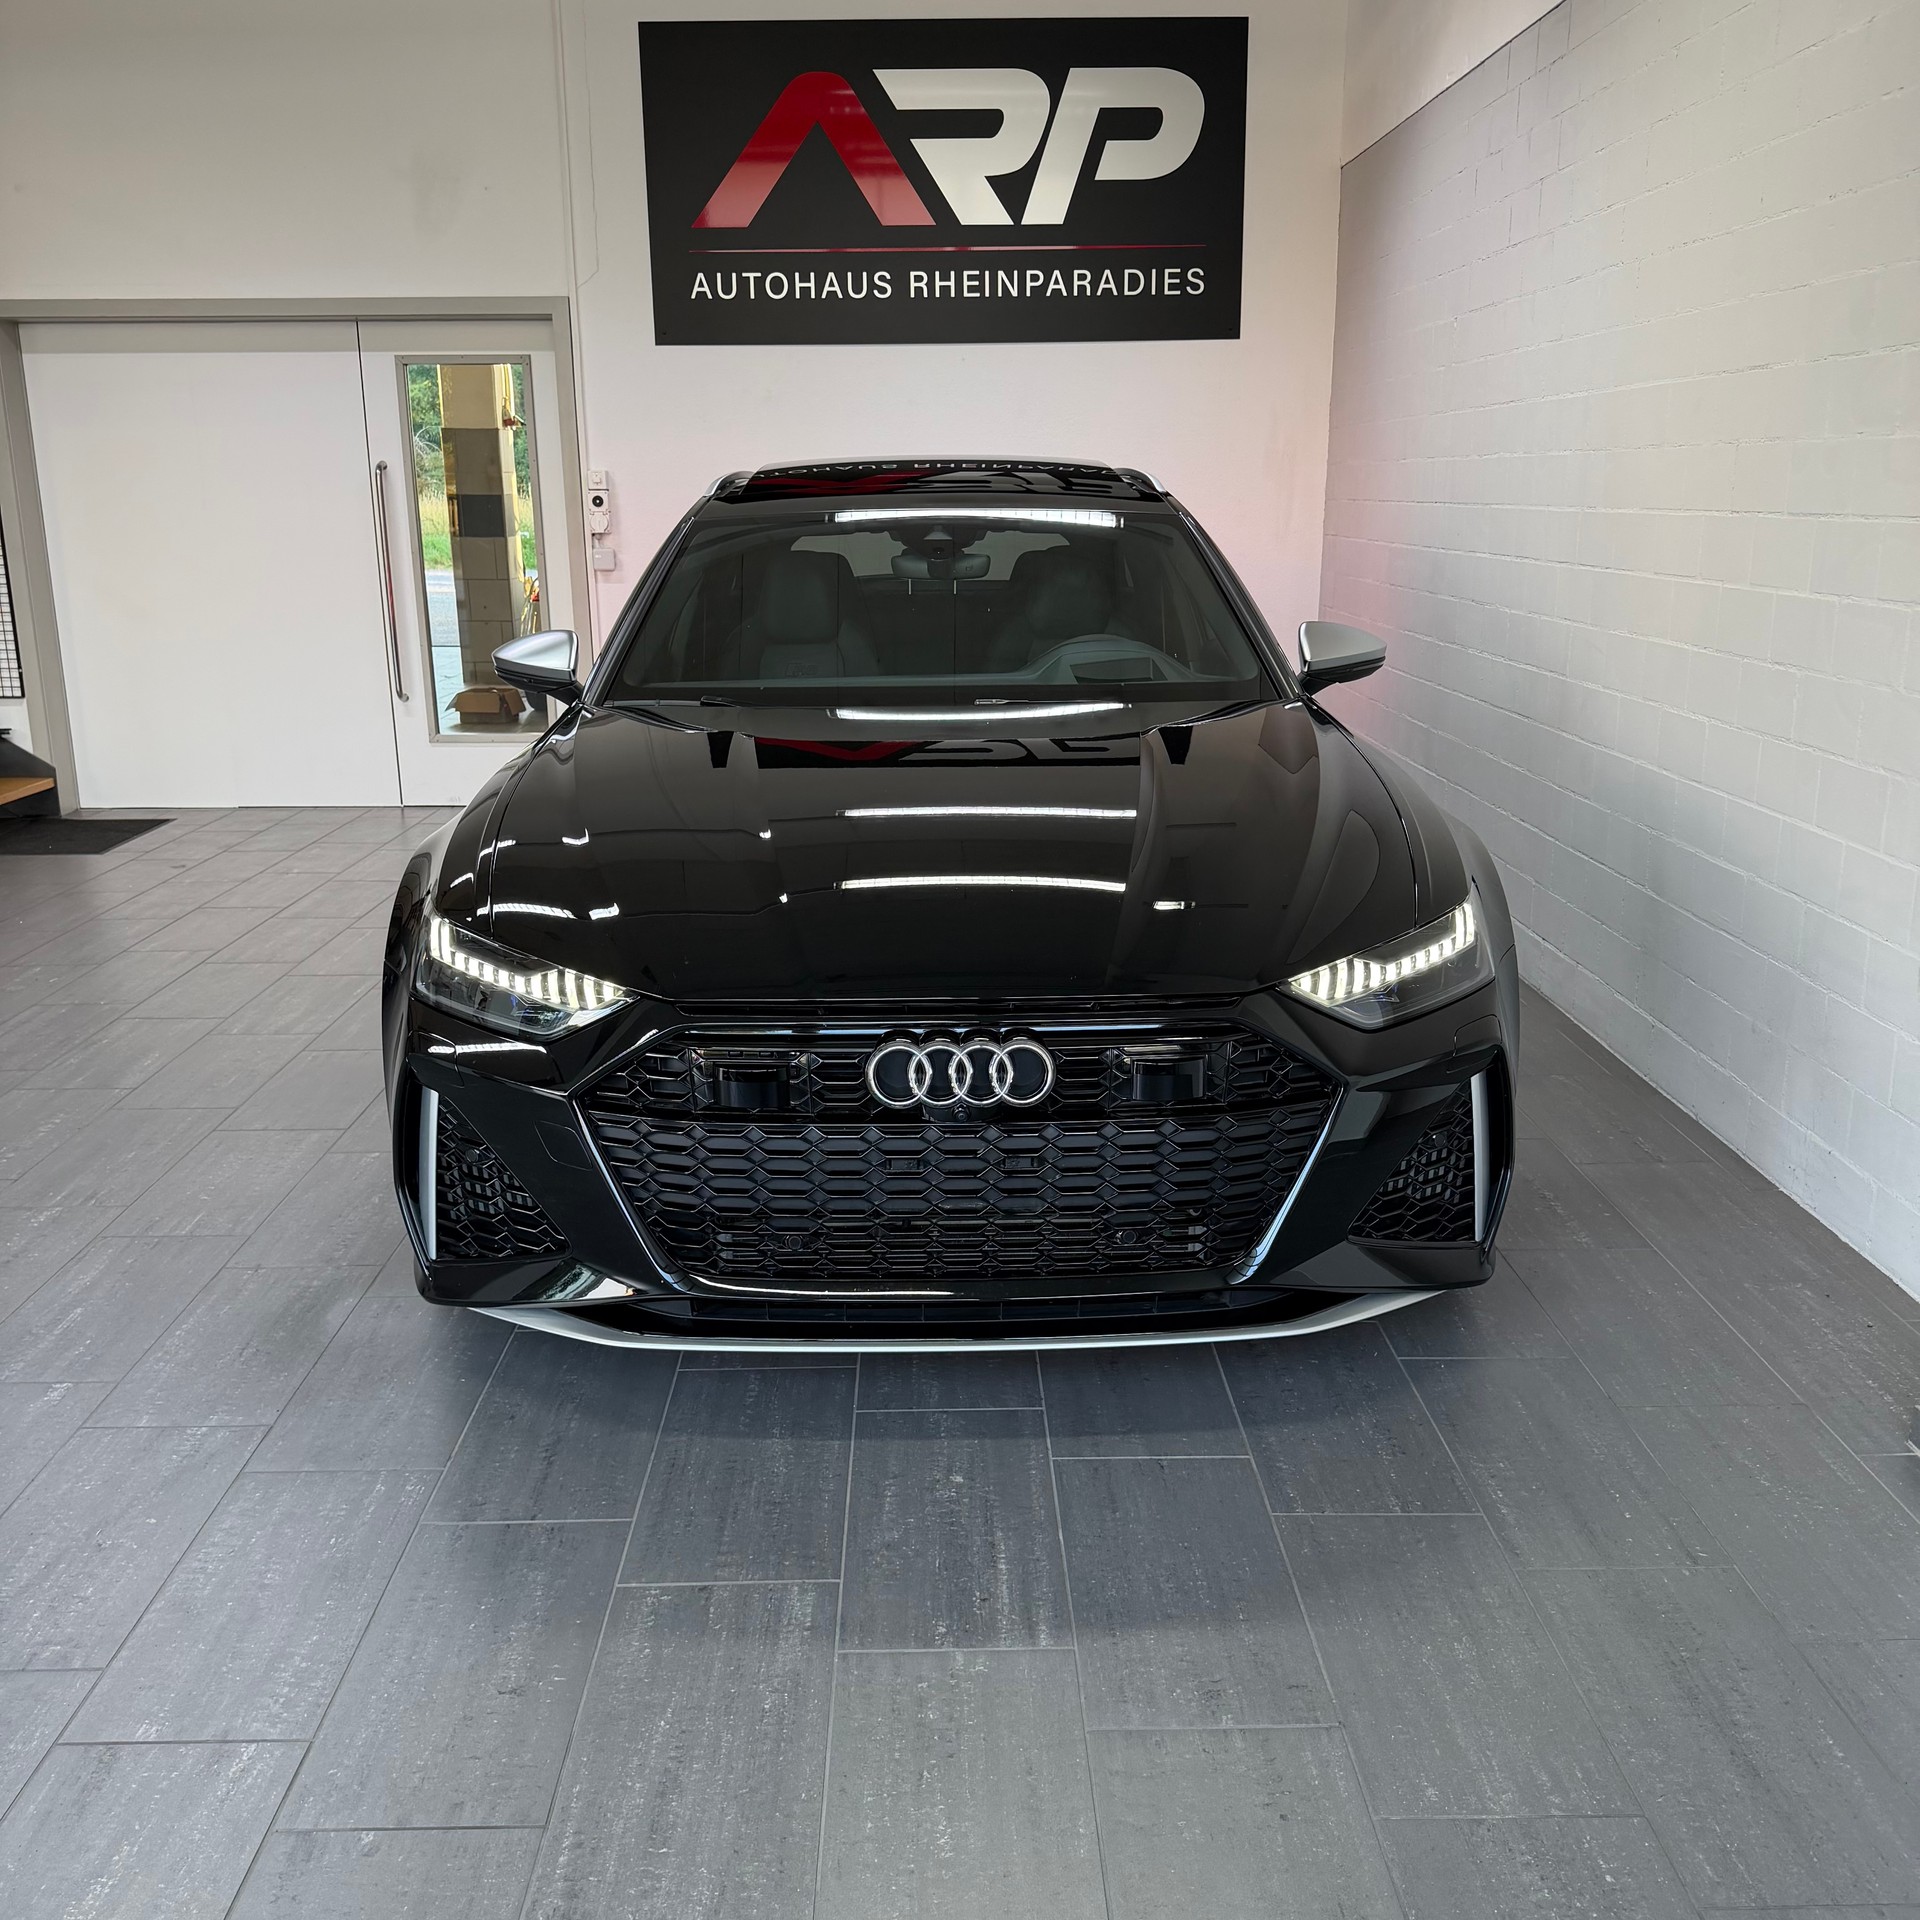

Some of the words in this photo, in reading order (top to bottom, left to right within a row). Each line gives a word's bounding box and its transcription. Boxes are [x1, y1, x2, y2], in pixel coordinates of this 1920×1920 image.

[691, 66, 1205, 228] ARP
[690, 271, 892, 299] AUTOHAUS
[909, 267, 1205, 298] RHEINPARADIES
